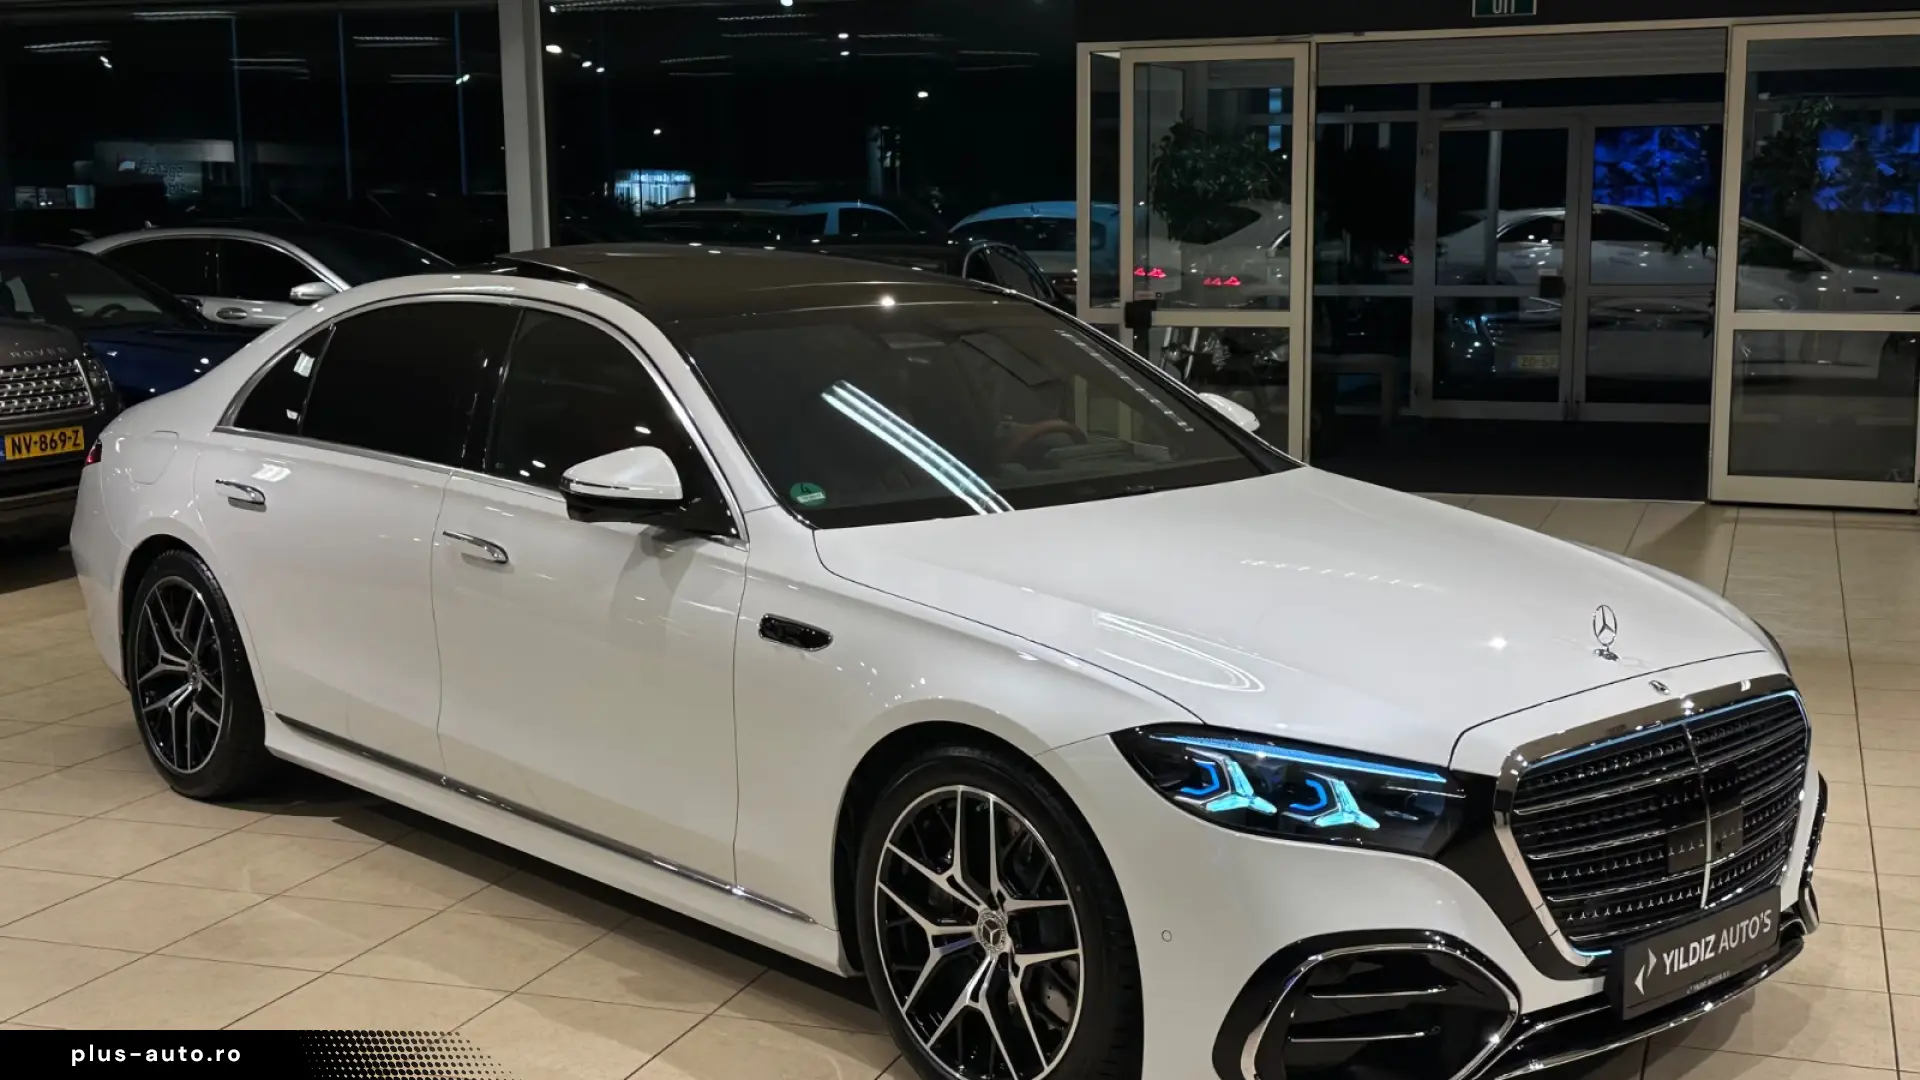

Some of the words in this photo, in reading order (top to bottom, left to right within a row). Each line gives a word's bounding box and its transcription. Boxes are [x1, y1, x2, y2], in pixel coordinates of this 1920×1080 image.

[9, 346, 68, 358] ROVER
[11, 429, 81, 457] NV-869-Z
[1662, 934, 1716, 975] YILDIZ
[1718, 909, 1772, 954] AUTO'S
